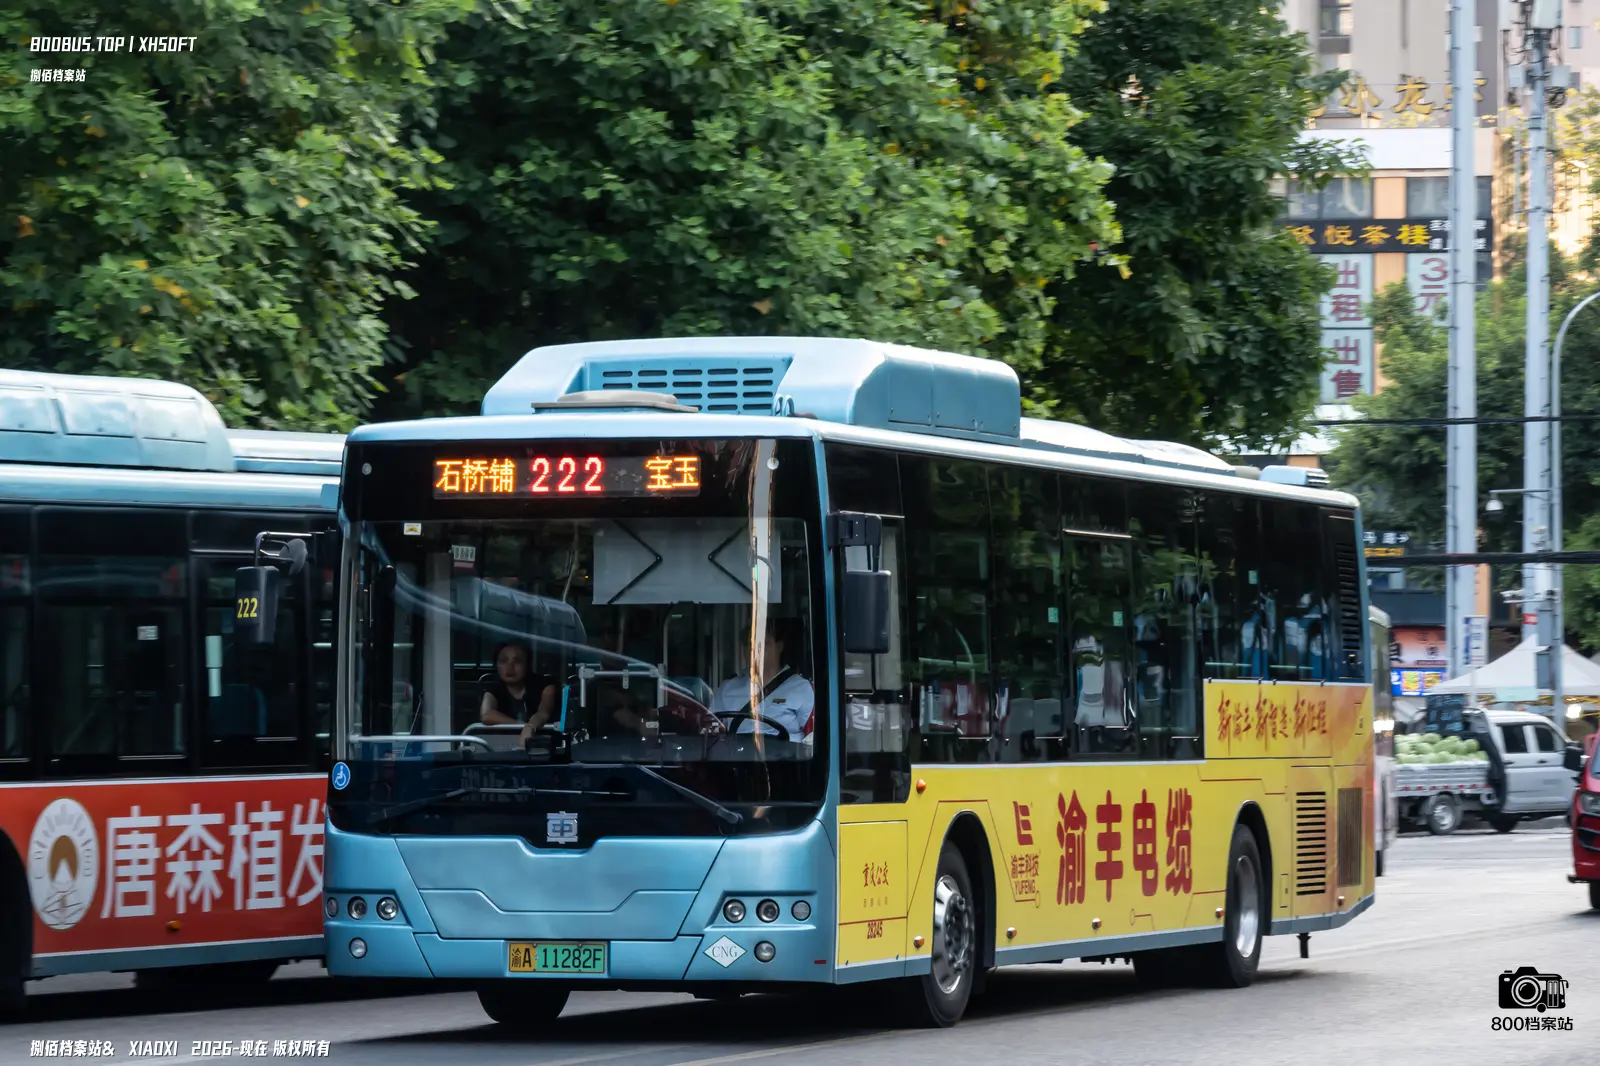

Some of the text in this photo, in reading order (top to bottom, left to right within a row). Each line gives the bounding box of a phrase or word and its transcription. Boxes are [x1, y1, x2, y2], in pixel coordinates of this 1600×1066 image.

[1332, 259, 1362, 322] 出租
[1330, 335, 1362, 398] 出售
[435, 456, 699, 493] 石桥铺 222 宝玉
[237, 598, 259, 618] 222
[100, 798, 326, 919] 唐森植发
[1056, 788, 1192, 905] 渝丰电缆
[1011, 852, 1039, 879] 渝丰科技
[1015, 879, 1036, 895] YUFENG
[712, 945, 738, 958] CNG
